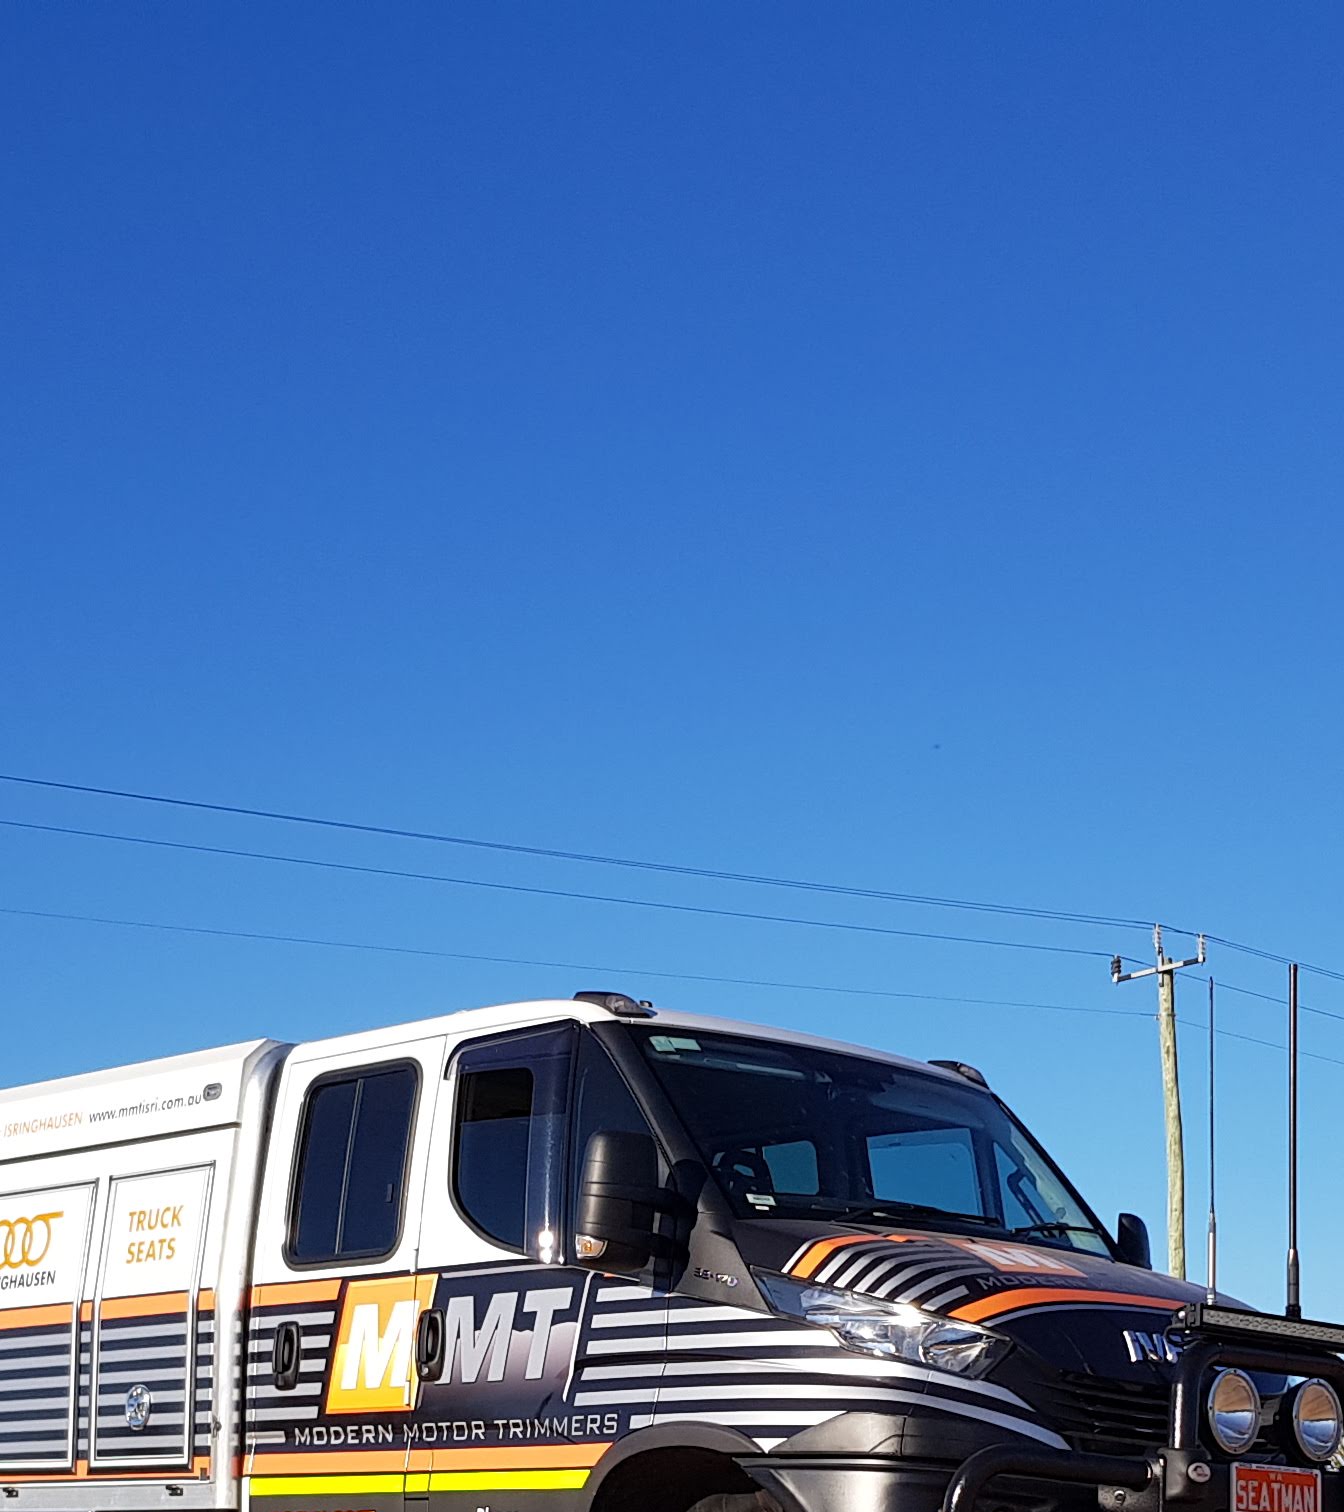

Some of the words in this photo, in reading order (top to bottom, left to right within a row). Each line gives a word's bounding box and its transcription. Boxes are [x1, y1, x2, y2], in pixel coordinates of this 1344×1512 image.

[4, 1112, 83, 1137] ISRINGHAUSEN
[89, 1094, 202, 1123] www.mmtisri.com.au
[129, 1205, 184, 1232] TRUCK
[126, 1237, 176, 1264] SEATS
[976, 1275, 1087, 1290] MODERN
[294, 1424, 393, 1446] MODERN
[402, 1421, 485, 1442] MOTOR
[494, 1415, 618, 1439] TRIMMERS
